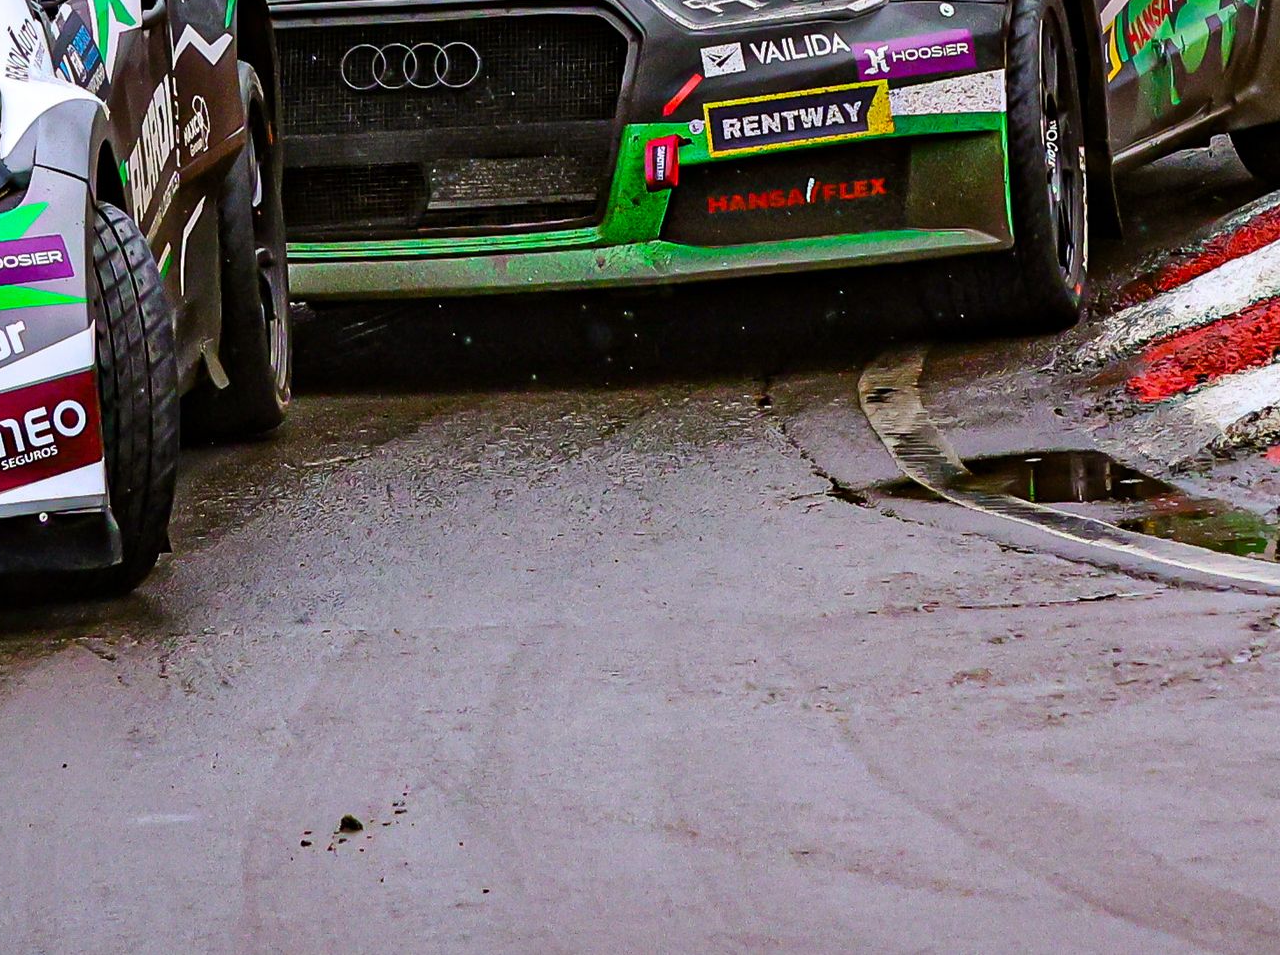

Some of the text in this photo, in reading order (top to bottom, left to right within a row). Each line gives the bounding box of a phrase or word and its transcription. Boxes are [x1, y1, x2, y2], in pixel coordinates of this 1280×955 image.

[749, 33, 851, 65] VAILIDA
[892, 42, 969, 63] HOOSIER
[722, 100, 862, 140] RENTWAY
[1, 445, 58, 470] SEGUROS
